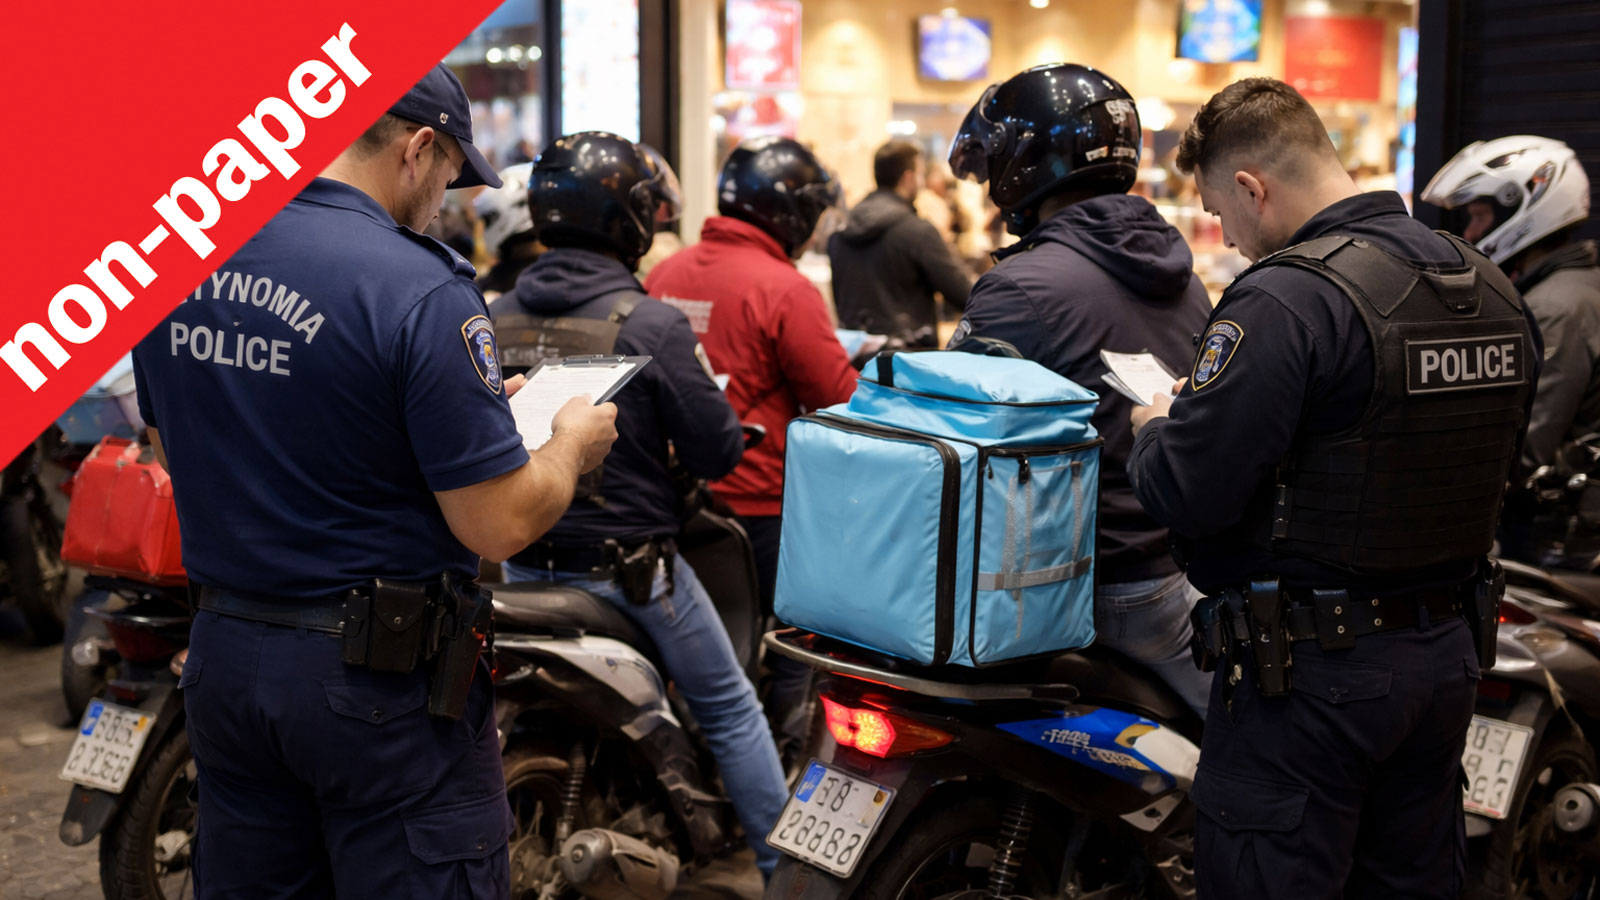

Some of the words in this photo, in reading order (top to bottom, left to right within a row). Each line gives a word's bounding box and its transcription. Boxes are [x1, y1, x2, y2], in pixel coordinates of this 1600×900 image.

[180, 271, 326, 345] YNOMIA
[170, 321, 292, 377] POLICE
[1420, 343, 1516, 384] POLICE
